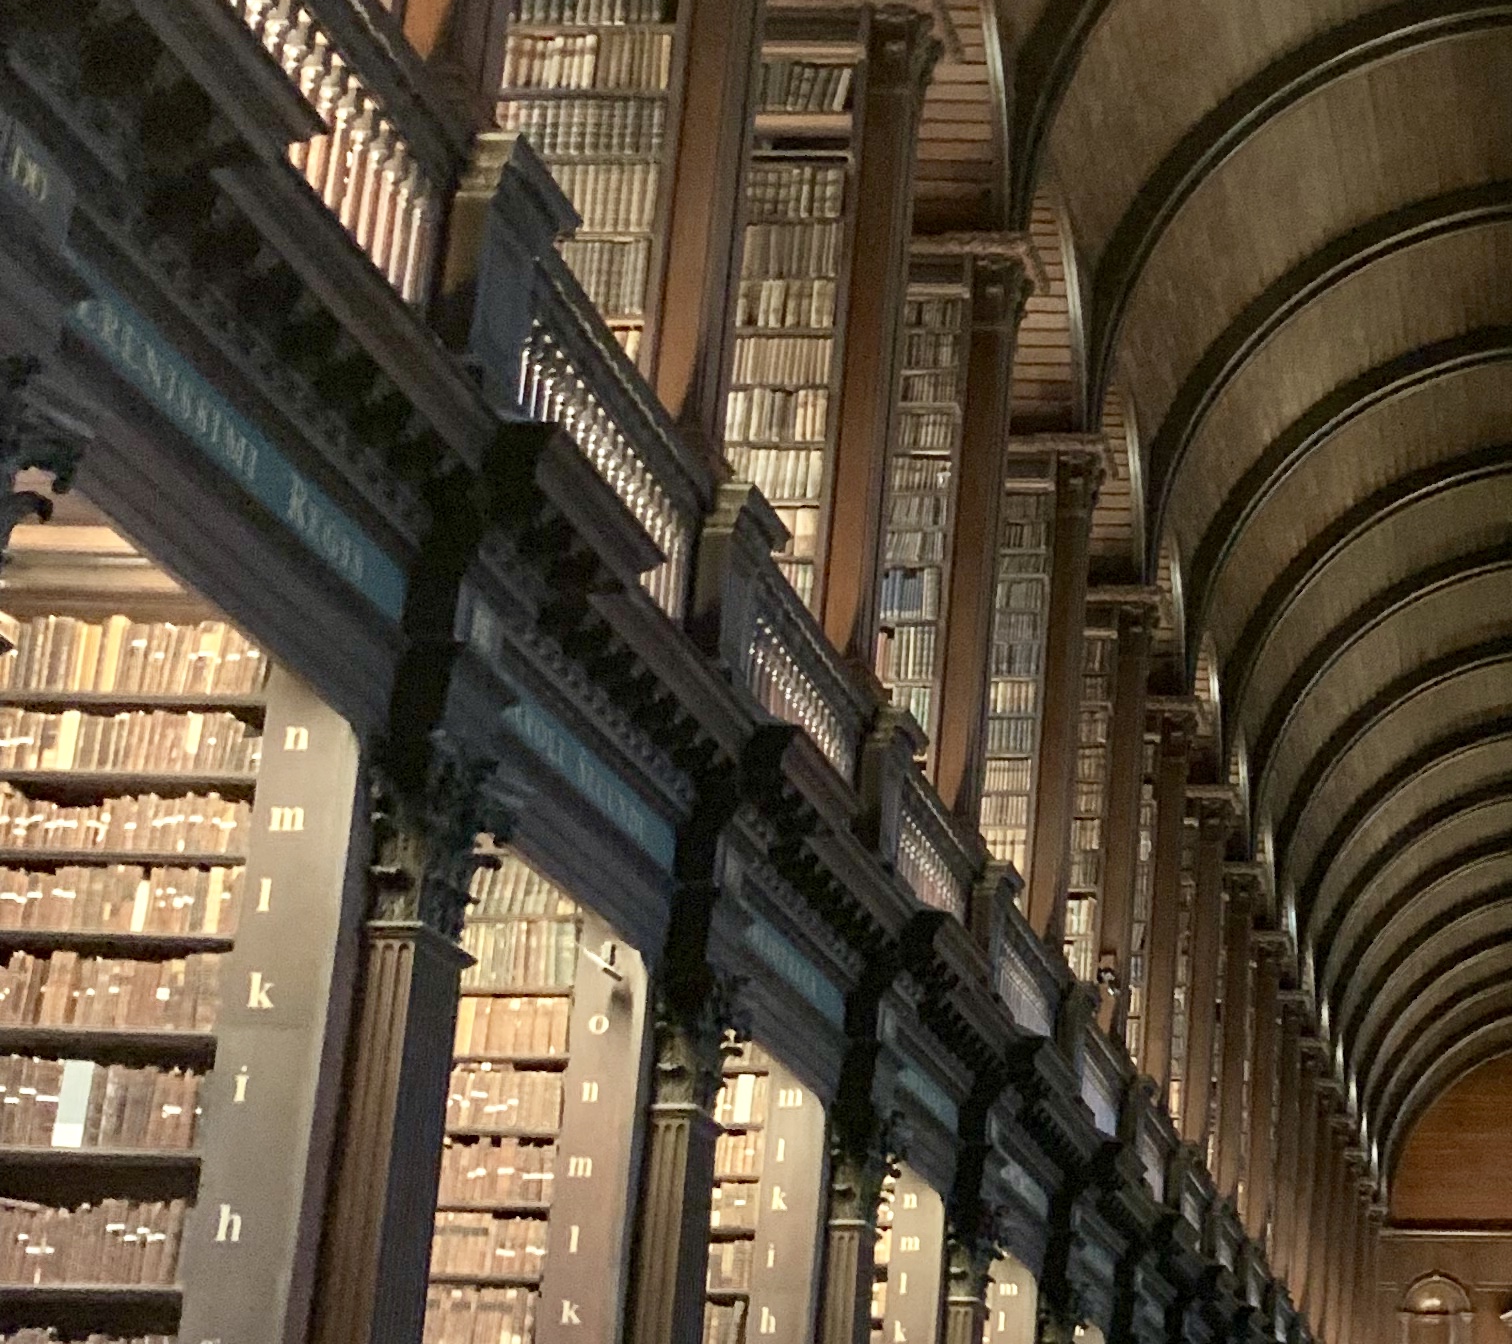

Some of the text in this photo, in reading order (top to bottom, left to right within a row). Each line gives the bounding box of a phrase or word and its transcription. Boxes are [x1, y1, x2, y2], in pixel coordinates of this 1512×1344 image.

[284, 727, 308, 750] n
[269, 807, 304, 831] m
[248, 972, 273, 1008] k
[589, 1015, 608, 1035] o
[234, 1066, 249, 1102] i
[582, 1082, 598, 1102] n
[779, 1090, 802, 1106] m
[568, 1157, 592, 1177] m
[772, 1186, 786, 1210] k
[216, 1204, 241, 1241] h
[901, 1237, 919, 1250] m
[1000, 1284, 1017, 1295] m
[562, 1300, 580, 1324] k
[760, 1307, 775, 1333] h
[895, 1321, 905, 1342] k
